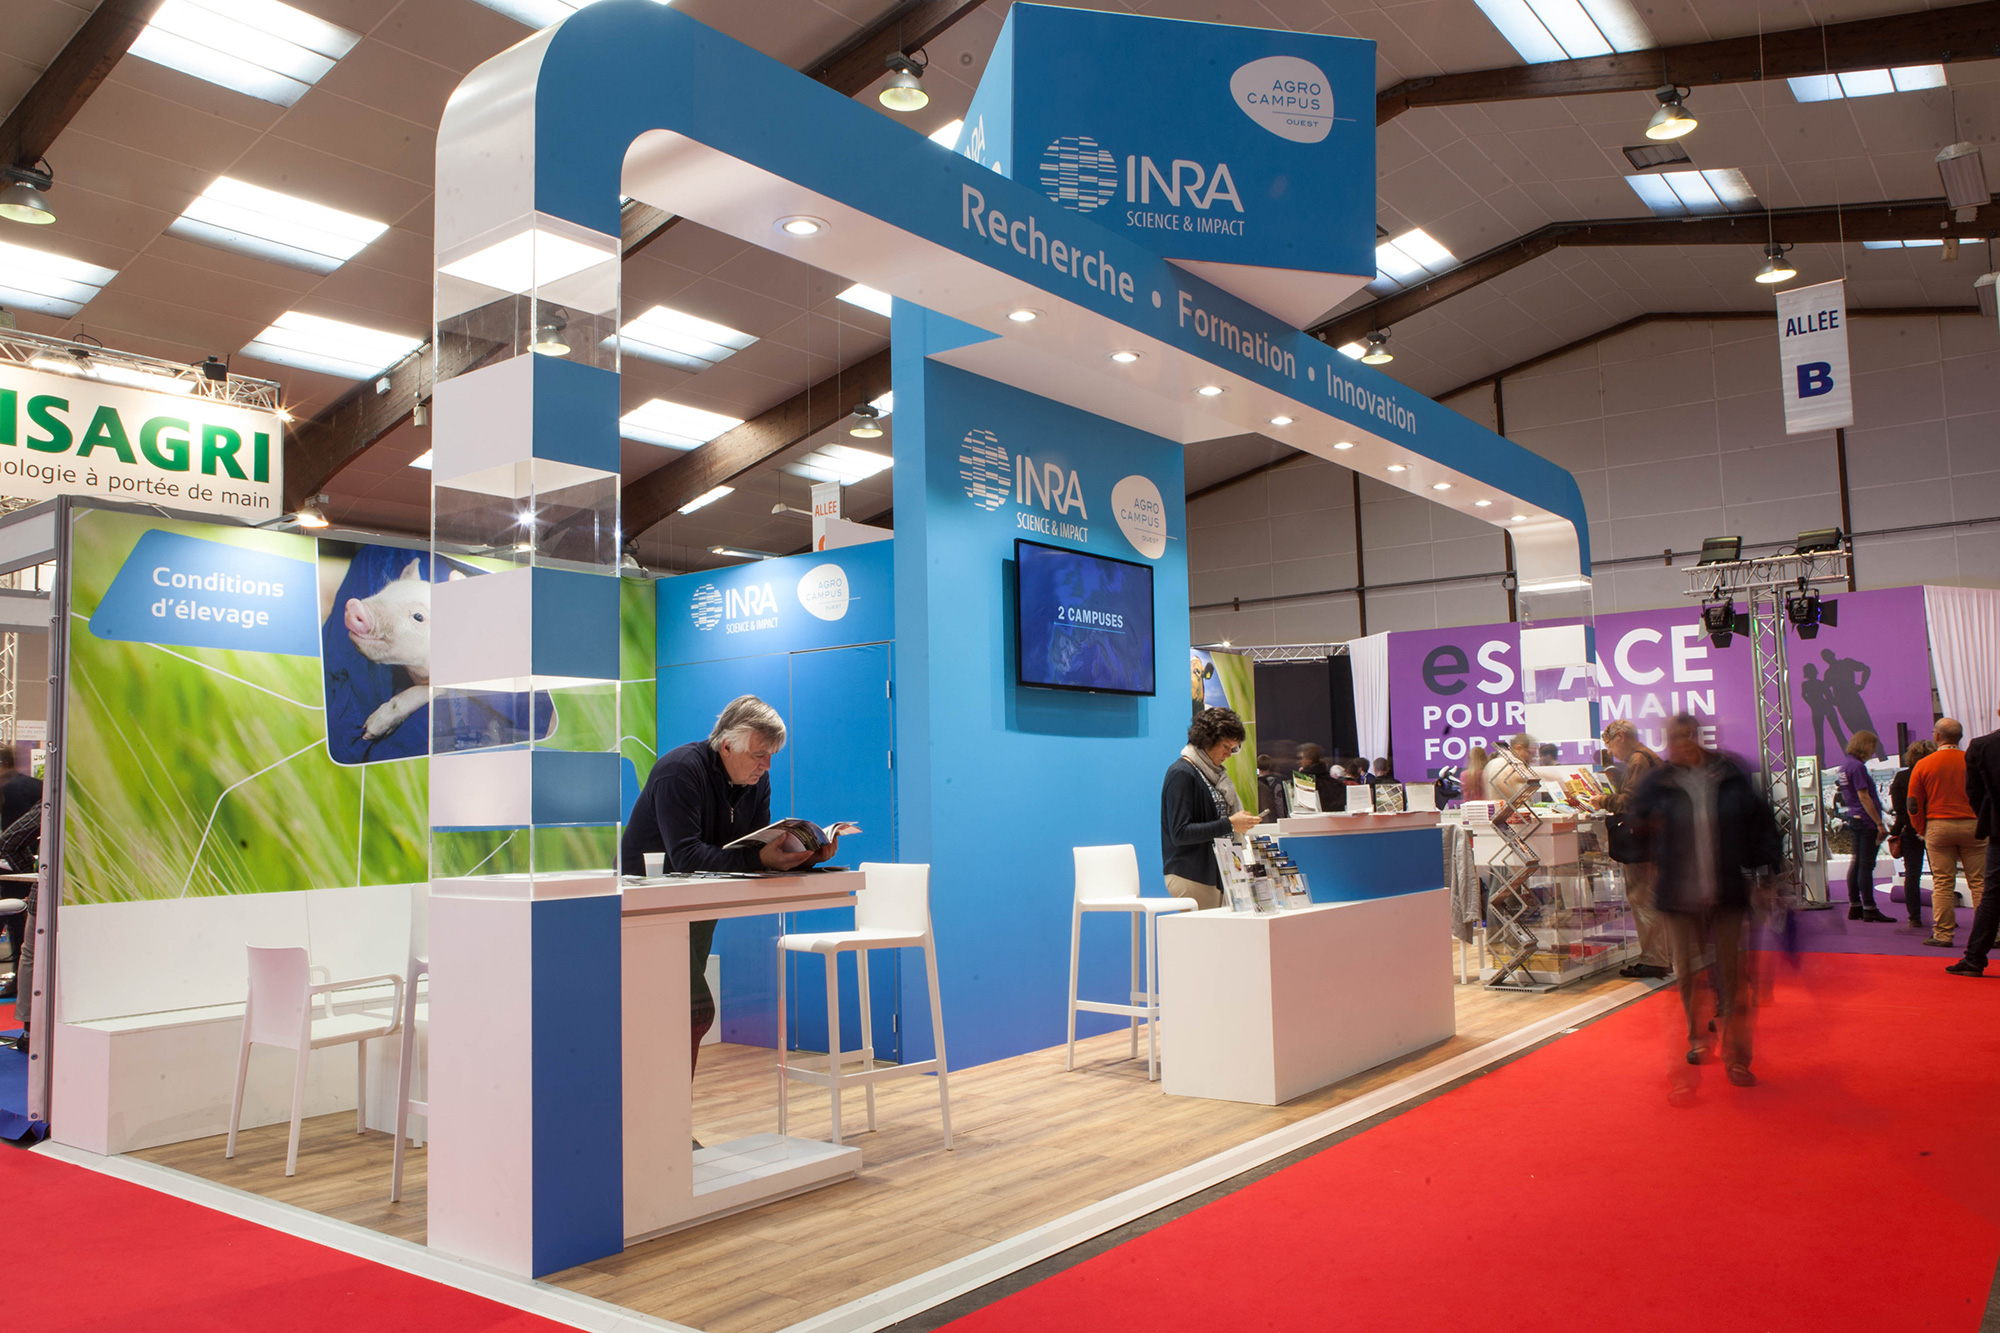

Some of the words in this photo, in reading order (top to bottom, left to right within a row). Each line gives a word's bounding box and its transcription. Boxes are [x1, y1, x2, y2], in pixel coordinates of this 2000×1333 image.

[1247, 92, 1321, 110] CAMPUS
[1272, 79, 1321, 95] AGRO
[1286, 118, 1319, 127] OUEST
[964, 113, 985, 163] RA
[1126, 154, 1245, 213] INRA
[1126, 210, 1180, 231] SCIENCE
[1183, 218, 1194, 232] &
[1197, 217, 1245, 236] IMPACT
[961, 183, 1135, 304] Recherche
[1178, 289, 1296, 380] Formation
[1326, 364, 1417, 436] Innovation
[1786, 309, 1839, 337] ALLÉE
[1796, 361, 1835, 399] B
[0, 388, 270, 484] ISAGRI
[0, 458, 76, 484] ologie
[86, 467, 98, 486] à
[109, 474, 179, 497] portée
[188, 484, 213, 501] de
[222, 491, 270, 509] main
[1016, 454, 1088, 520] INRA
[1120, 508, 1160, 528] CAMPUS
[1133, 497, 1160, 514] AGRO
[1016, 511, 1050, 535] SCIENCE
[1052, 521, 1058, 535] &
[1060, 522, 1088, 543] IMPACT
[1141, 535, 1159, 545] OUEST
[152, 566, 285, 597] Conditions
[805, 589, 843, 601] CAMPUS
[818, 578, 843, 590] AGRO
[151, 598, 270, 629] d’élevage
[725, 582, 779, 620] INRA
[725, 620, 749, 634] SCIENCE
[750, 620, 756, 631] &
[756, 617, 779, 631] IMPACT
[1058, 606, 1065, 620] 2
[1067, 607, 1124, 628] CAMPUSES
[1423, 701, 1526, 730] POUR
